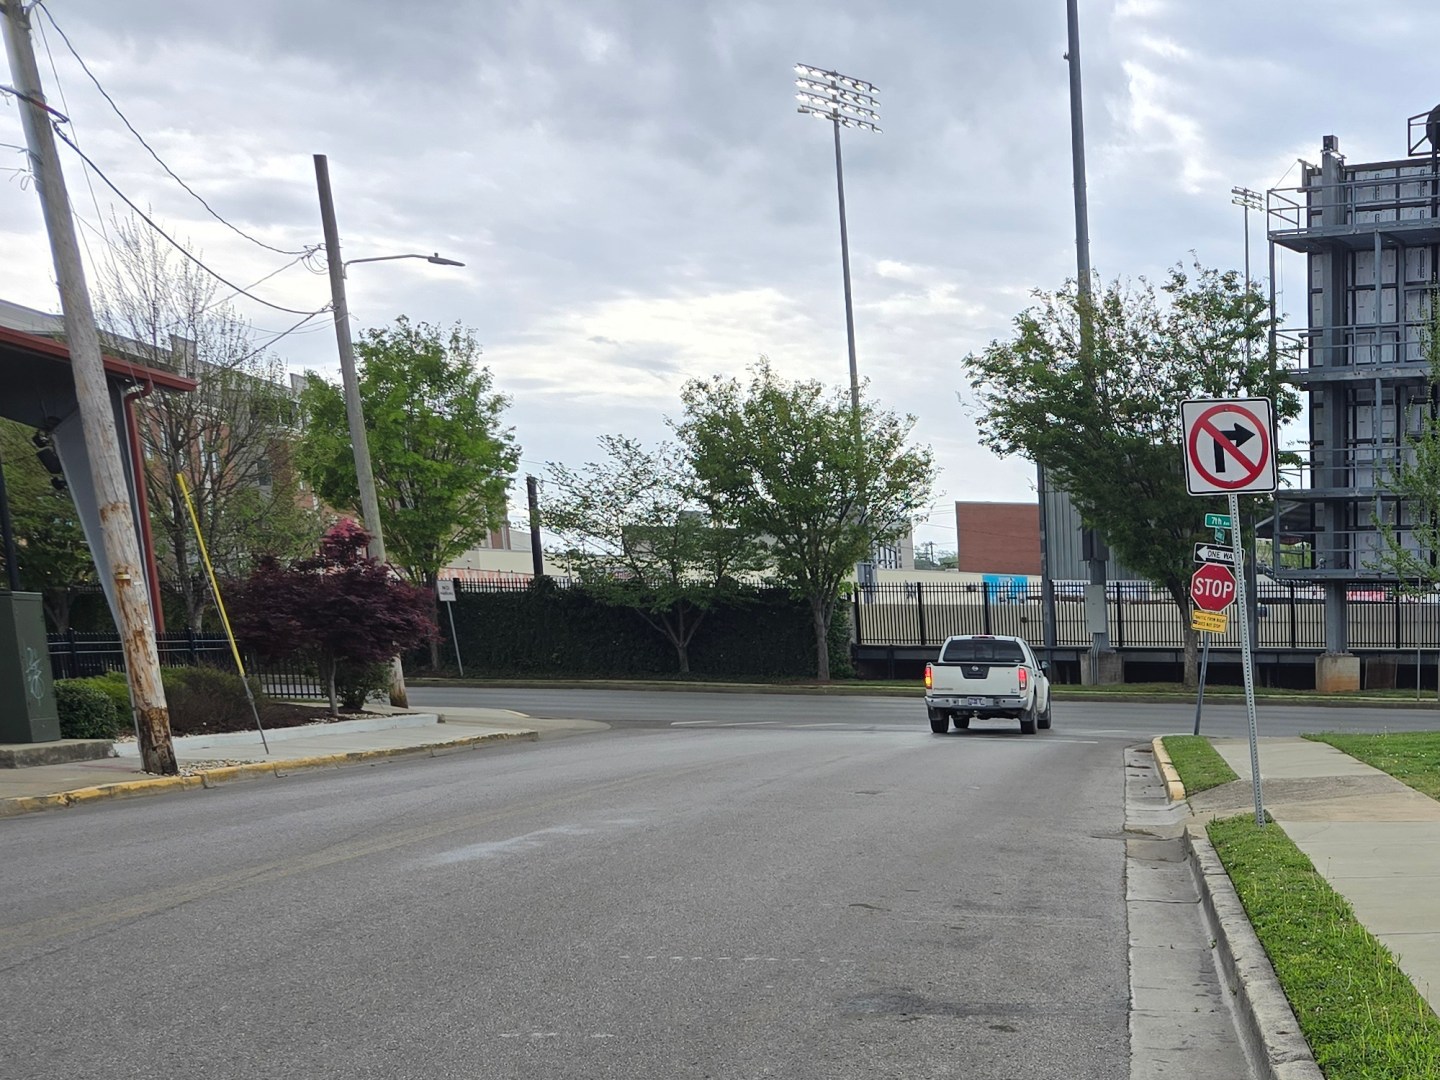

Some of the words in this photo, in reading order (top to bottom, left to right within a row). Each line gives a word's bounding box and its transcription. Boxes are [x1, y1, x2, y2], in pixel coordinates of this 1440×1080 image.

[1211, 516, 1222, 526] 7th
[1207, 550, 1221, 559] ONE
[1223, 552, 1234, 560] WA
[1194, 577, 1233, 599] STOP
